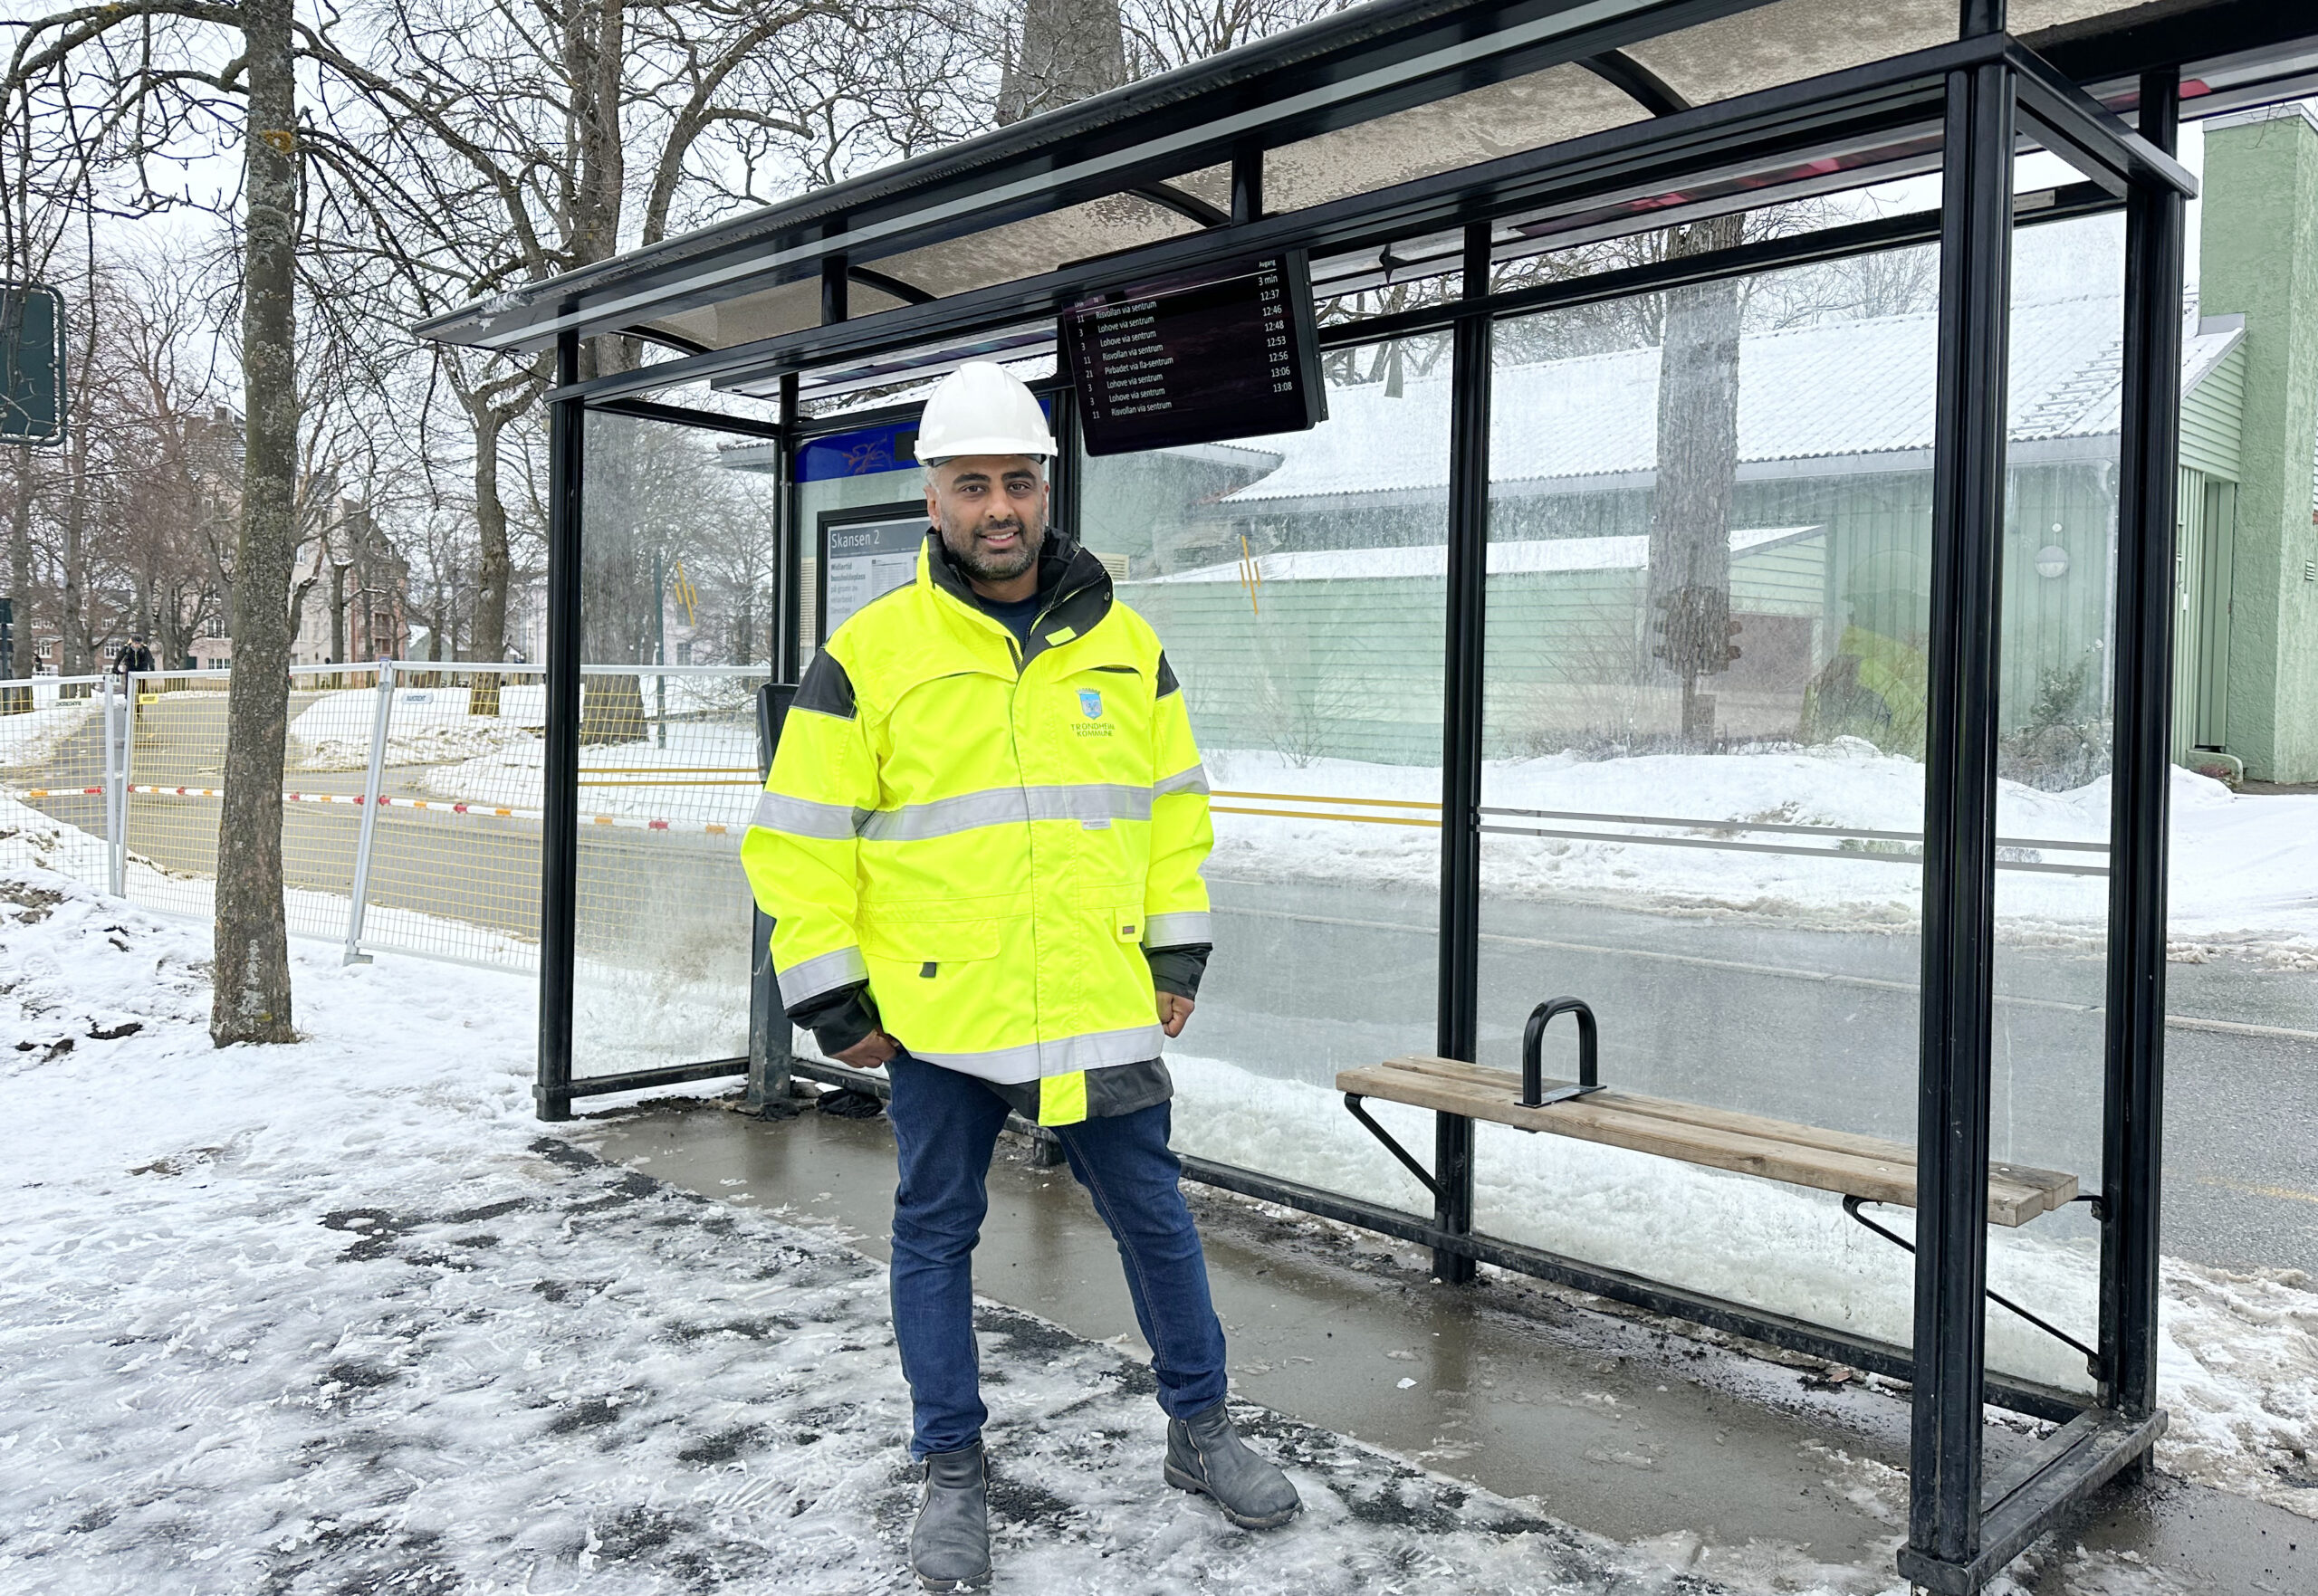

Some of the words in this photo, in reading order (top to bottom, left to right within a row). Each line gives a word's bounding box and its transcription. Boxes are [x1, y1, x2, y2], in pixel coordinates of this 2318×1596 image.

[1076, 314, 1085, 324] 11
[1095, 309, 1121, 320] Risvollan
[1122, 305, 1131, 314] via
[1132, 301, 1157, 311] sentrum
[1258, 276, 1263, 286] 3
[1264, 274, 1278, 284] min
[1078, 329, 1084, 338] 3
[1097, 324, 1119, 334] Lohove
[1119, 320, 1128, 329] via
[1129, 316, 1154, 327] sentrum
[1260, 289, 1279, 301] 12:37
[1080, 342, 1086, 351] 3
[1100, 338, 1121, 348] Lohove
[1122, 334, 1131, 343] via
[1132, 330, 1157, 341] sentrum
[1262, 304, 1282, 317] 12:46
[1083, 356, 1091, 365] 11
[1102, 349, 1128, 361] Risvollan
[1128, 348, 1137, 357] via
[1138, 344, 1164, 354] sentrum
[1264, 320, 1285, 332] 12:48
[1086, 369, 1094, 378] 21
[1105, 364, 1129, 375] Pirbadet
[1130, 362, 1139, 371] via
[1267, 335, 1287, 348] 12:53
[1087, 384, 1093, 392] 3
[1106, 378, 1128, 389] Lohove
[1128, 377, 1137, 386] via
[1138, 373, 1164, 384] sentrum
[1269, 350, 1288, 363] 12:56
[1089, 397, 1095, 406] 3
[1109, 393, 1130, 403] Lohove
[1130, 390, 1139, 399] via
[1140, 387, 1165, 398] sentrum
[1270, 366, 1291, 378] 13:06
[1092, 410, 1101, 419] 11
[1111, 406, 1136, 416] Risvollan
[1137, 404, 1146, 413] via
[1146, 401, 1173, 411] sentrum
[1273, 381, 1293, 393] 13:08
[831, 532, 871, 549] Skansen
[873, 529, 880, 545] 2
